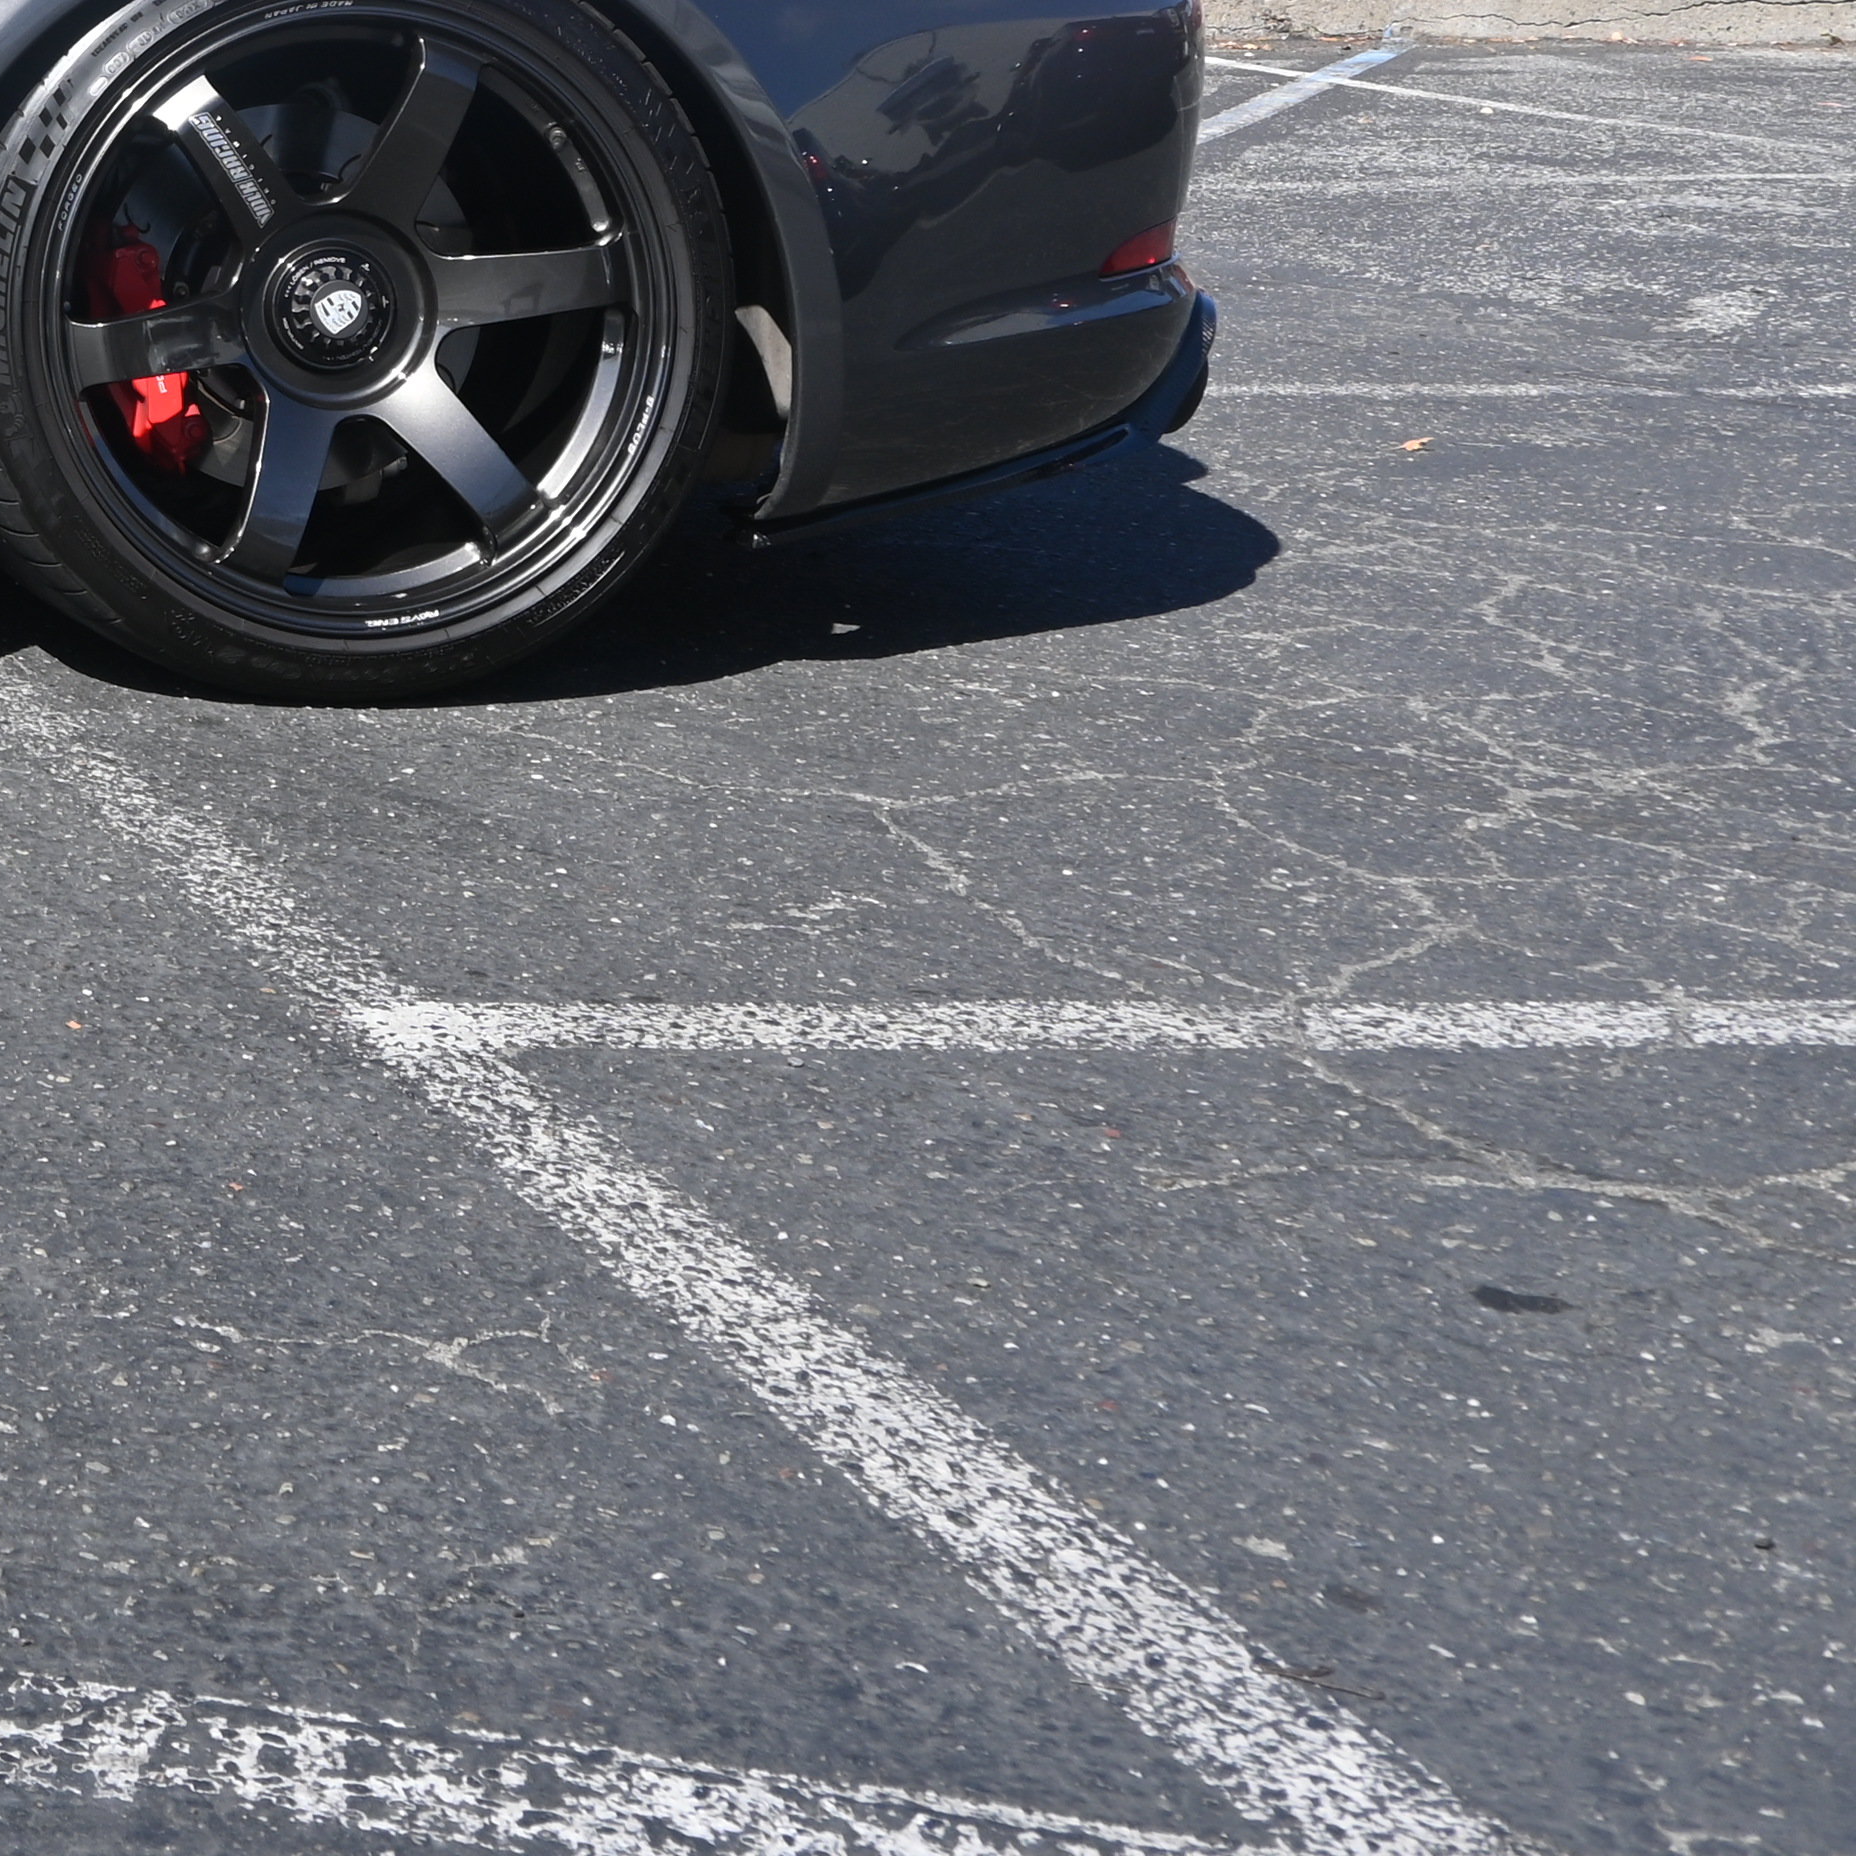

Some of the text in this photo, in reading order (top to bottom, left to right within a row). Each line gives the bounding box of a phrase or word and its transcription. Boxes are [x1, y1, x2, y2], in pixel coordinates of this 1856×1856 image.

[264, 4, 305, 20] JAPAN
[321, 0, 354, 8] MADE
[190, 114, 272, 226] VOLK RACING
[58, 173, 83, 232] FORGED
